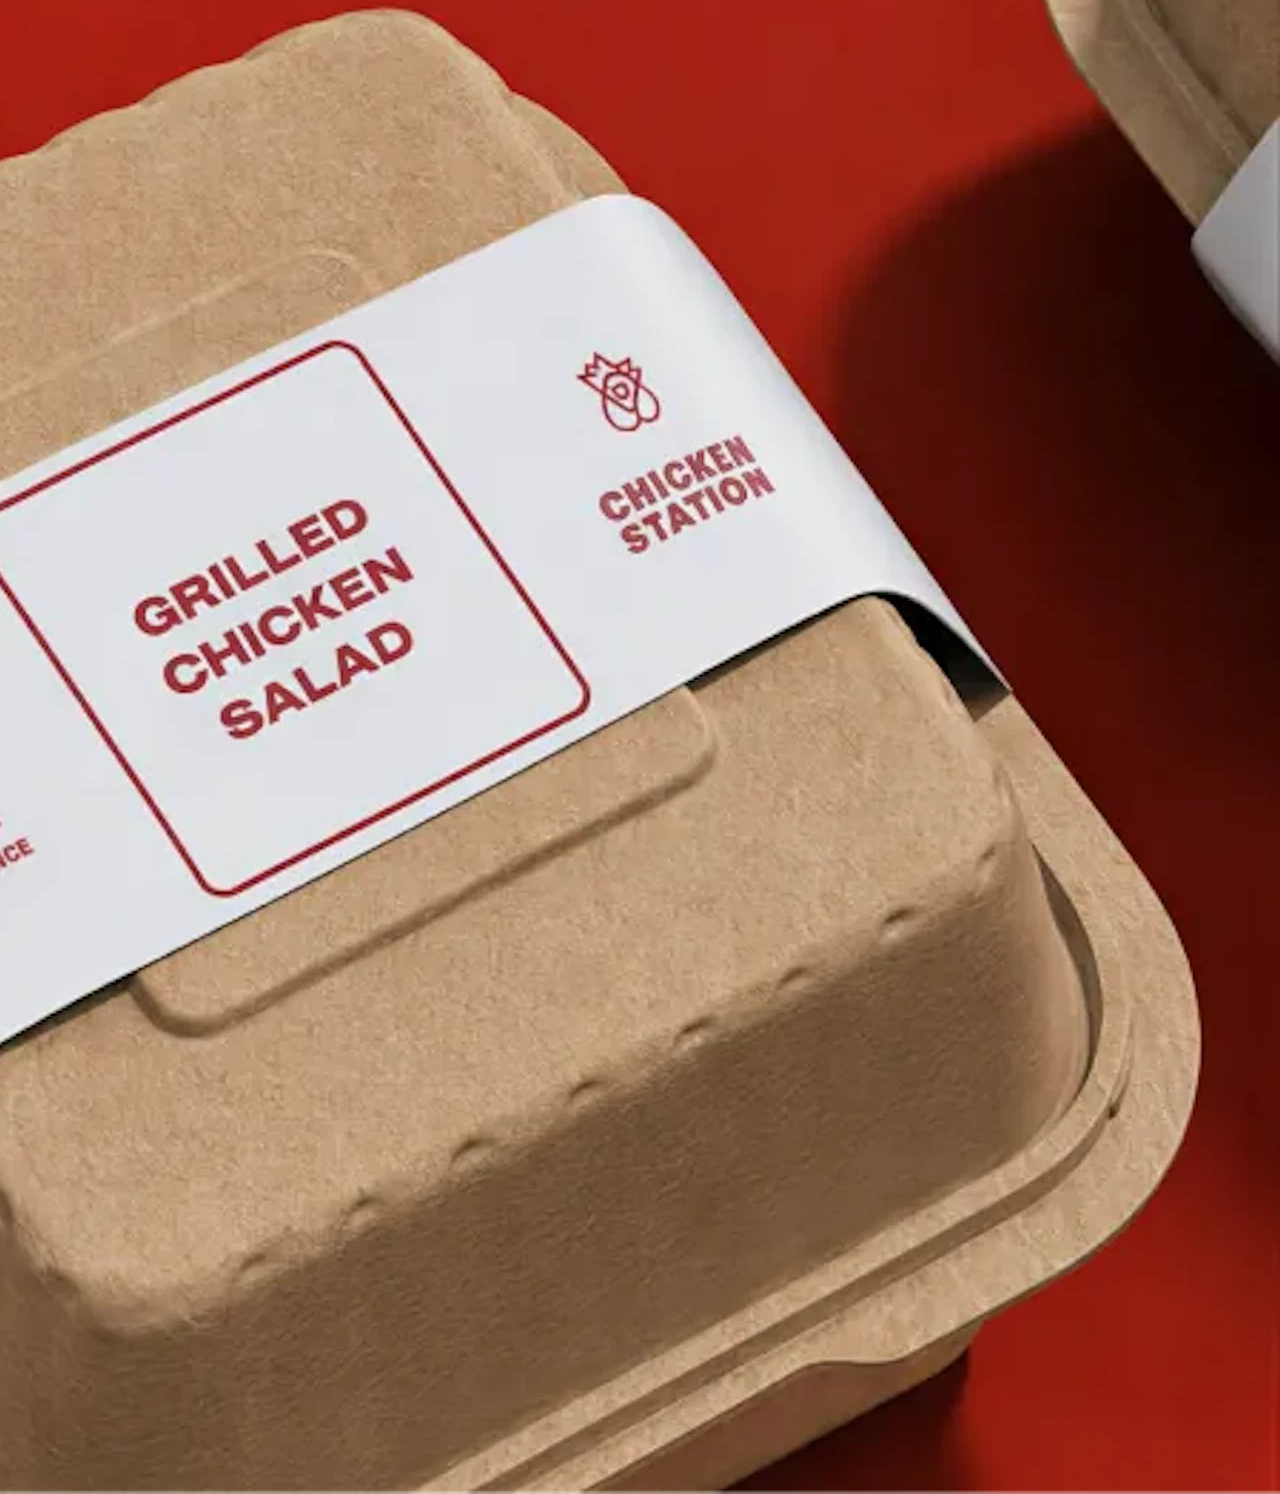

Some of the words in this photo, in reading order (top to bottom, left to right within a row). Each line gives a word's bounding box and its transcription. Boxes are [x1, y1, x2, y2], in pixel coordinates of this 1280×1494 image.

[599, 436, 756, 521] CHICKEN
[621, 468, 775, 554] STATION
[133, 499, 369, 637] GRILLED
[162, 545, 415, 696] CHICKEN
[220, 619, 415, 740] SALAD
